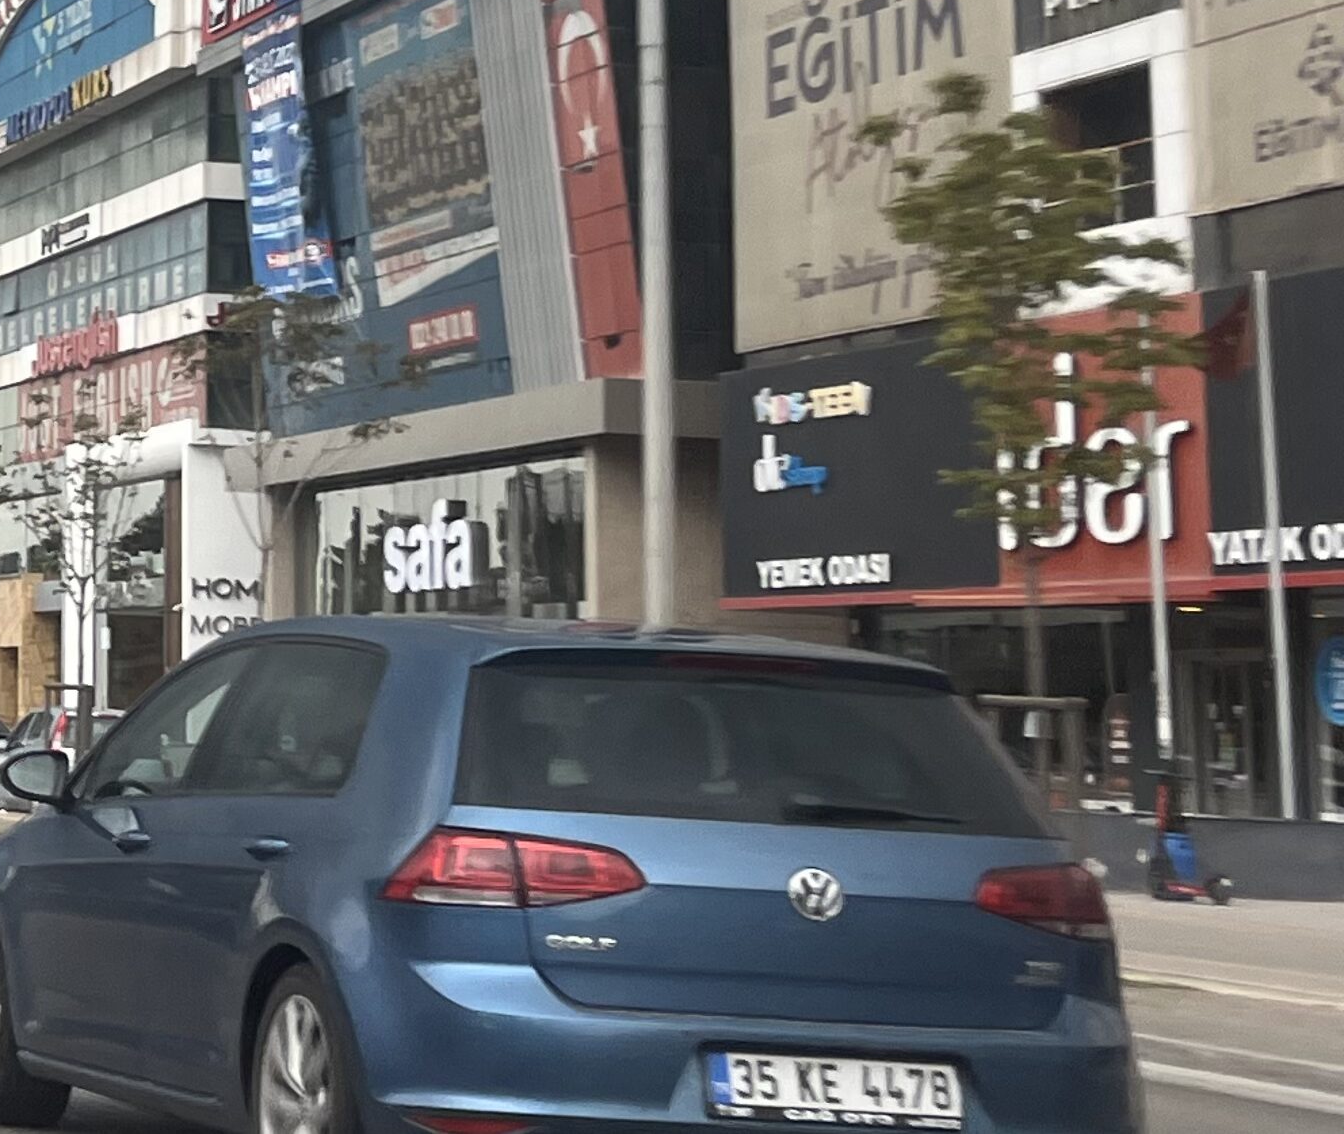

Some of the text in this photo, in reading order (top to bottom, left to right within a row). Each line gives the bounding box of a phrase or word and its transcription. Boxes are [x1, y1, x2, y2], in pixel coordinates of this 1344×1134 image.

[70, 64, 112, 112] KURS
[383, 498, 472, 594] safa
[756, 553, 891, 588] YEMEK ODASI
[733, 1059, 954, 1111] 35 KE 4478
